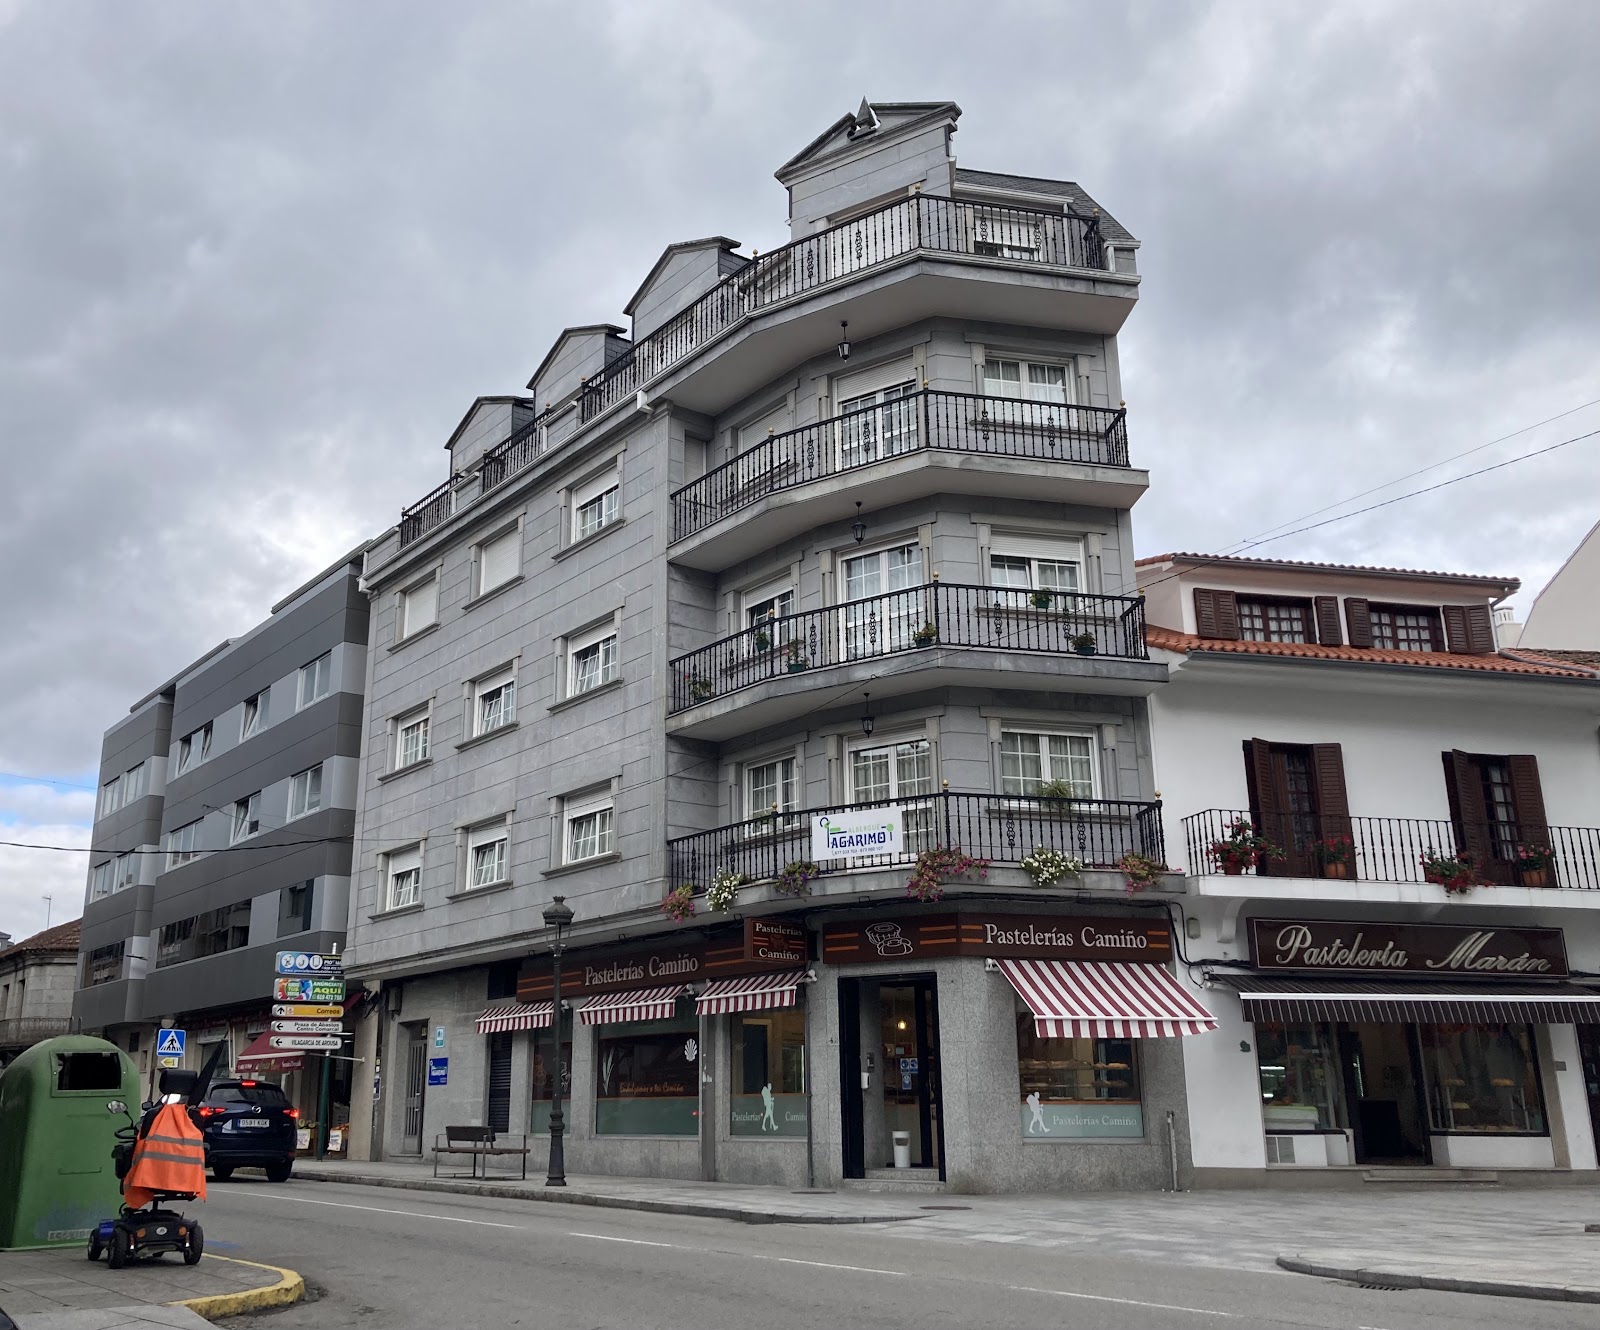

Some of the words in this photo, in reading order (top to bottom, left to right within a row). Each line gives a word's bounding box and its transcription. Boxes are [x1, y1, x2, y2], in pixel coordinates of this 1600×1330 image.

[847, 824, 881, 833] ALBERGUE
[831, 831, 886, 849] AGARIMO
[755, 922, 803, 936] Pastelerías
[984, 923, 1074, 946] Pastelerías
[1081, 926, 1147, 949] Camiño
[758, 947, 800, 960] Camiño
[1275, 924, 1409, 967] Pastelería
[1425, 931, 1551, 972] Marán
[584, 960, 645, 986] Pastelerías
[648, 953, 699, 977] Camiño
[731, 1111, 760, 1121] Pastelerías
[1052, 1115, 1100, 1125] Pastelerías
[1101, 1115, 1137, 1126] Camiño
